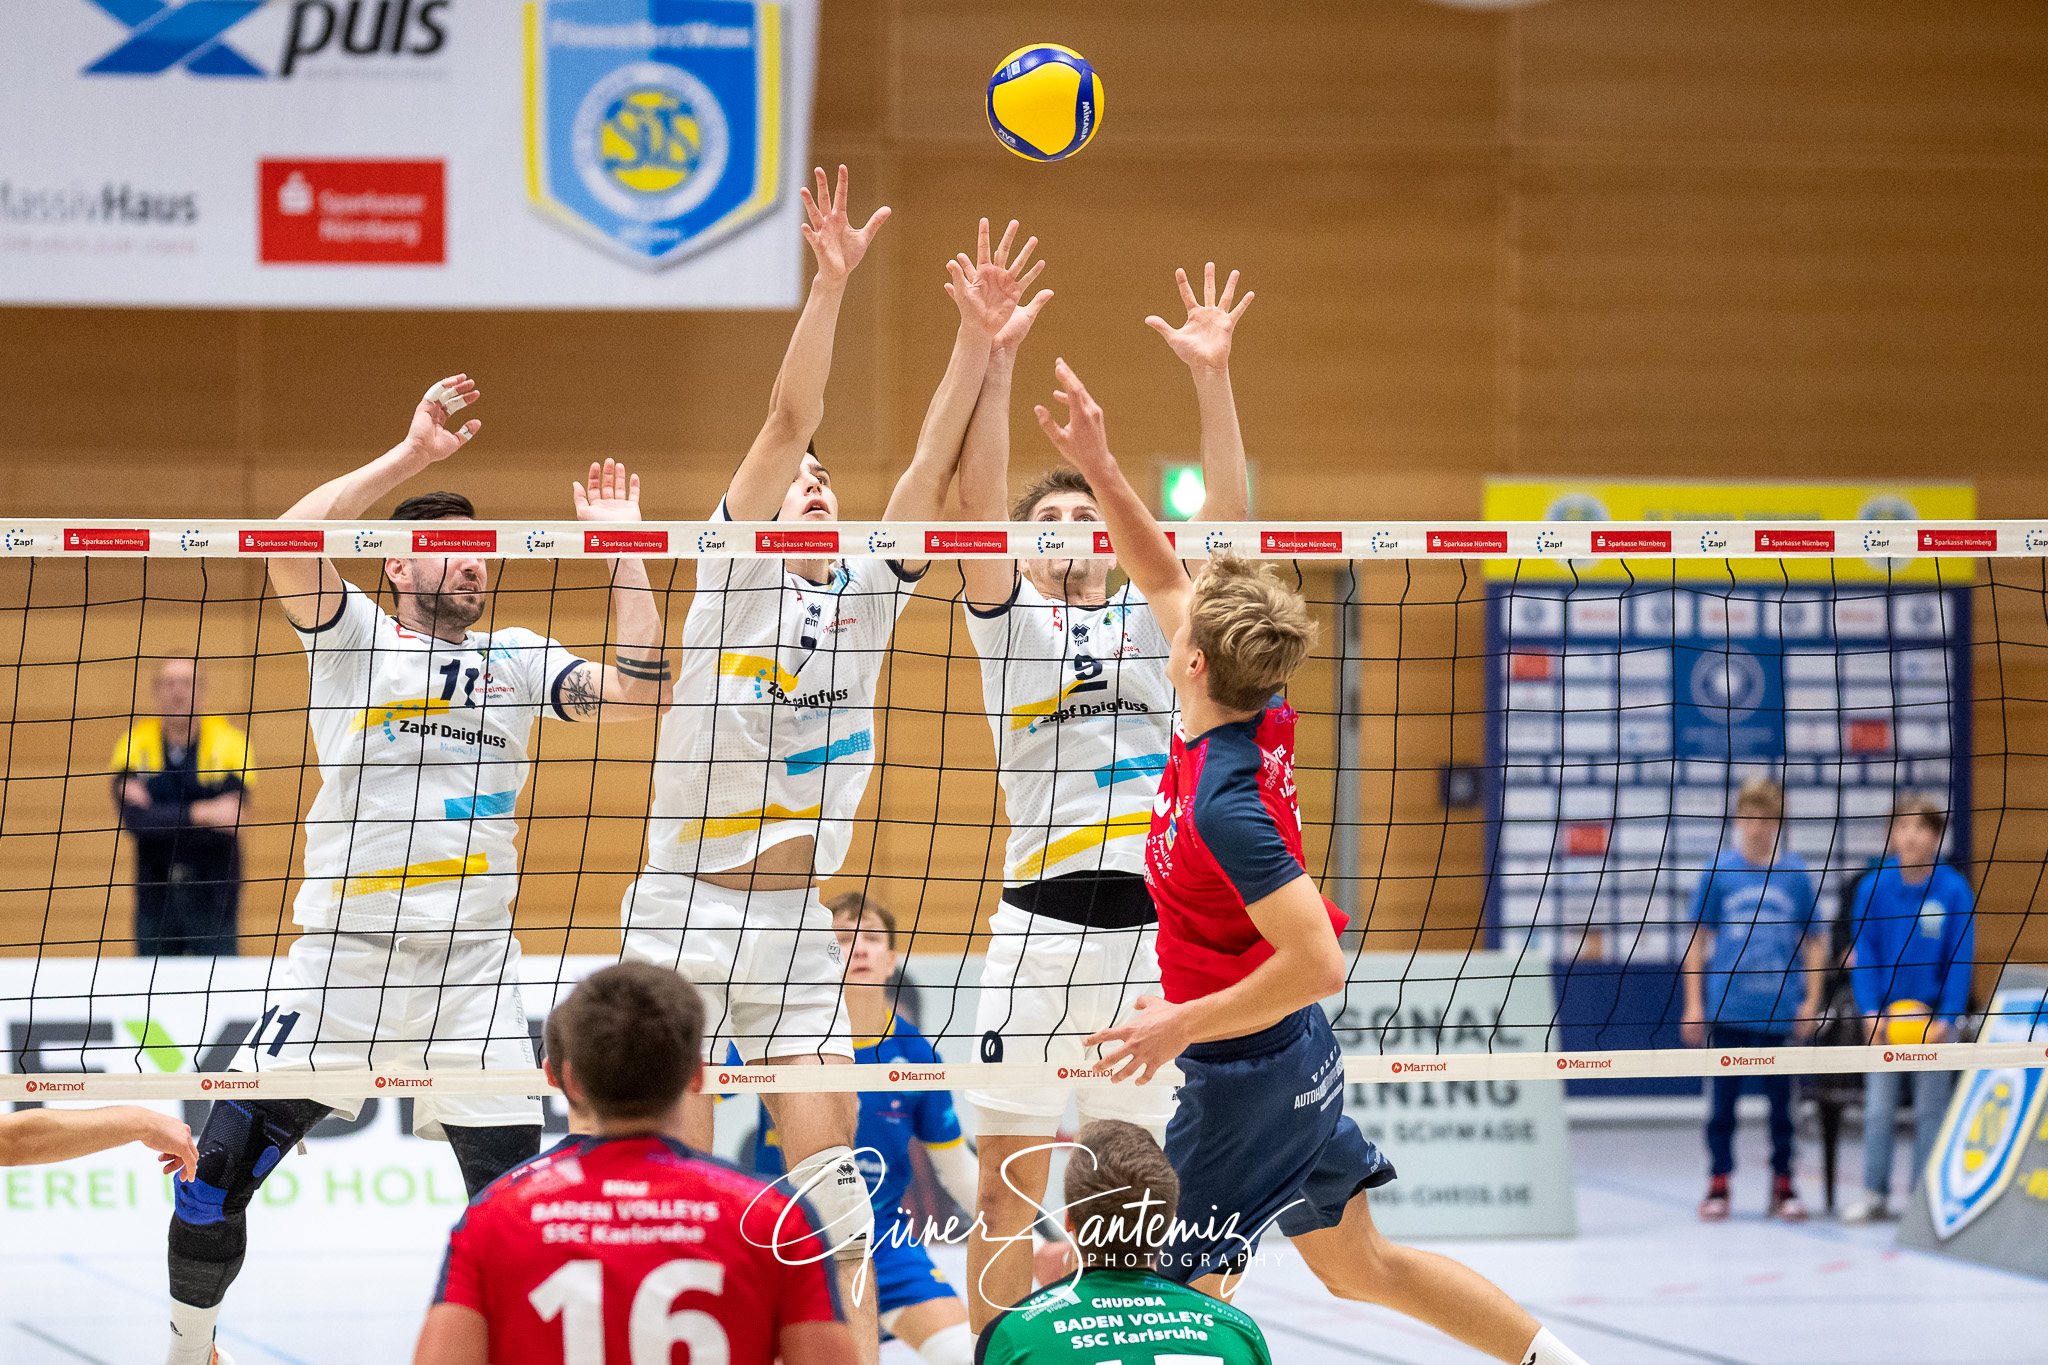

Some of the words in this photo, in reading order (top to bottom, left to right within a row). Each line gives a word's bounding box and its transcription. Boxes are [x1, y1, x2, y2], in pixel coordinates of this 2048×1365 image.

[13, 538, 34, 547] Zapf
[81, 538, 113, 547] Sparkasse
[114, 537, 144, 547] Nürnberg
[189, 539, 209, 548] Zapf
[256, 539, 287, 548] Sparkasse
[288, 538, 318, 548] Nürnberg
[362, 540, 383, 549] Zapf
[429, 539, 460, 548] Sparkasse
[461, 538, 491, 548] Nürnberg
[534, 540, 555, 549] Zapf
[601, 540, 632, 549] Sparkasse
[633, 539, 663, 549] Nürnberg
[705, 541, 725, 550] Zapf
[773, 540, 803, 549] Sparkasse
[804, 539, 834, 549] Nürnberg
[876, 540, 896, 549] Zapf
[941, 540, 972, 549] Sparkasse
[973, 539, 1002, 549] Nürnberg
[1045, 541, 1065, 550] Zapf
[1213, 541, 1232, 549] Zapf
[1277, 540, 1307, 549] Sparkasse
[1308, 539, 1337, 549] Nürnberg
[1379, 541, 1398, 549] Zapf
[1443, 540, 1473, 549] Sparkasse
[1474, 539, 1502, 549] Nürnberg
[1544, 540, 1563, 549] Zapf
[1607, 540, 1637, 549] Sparkasse
[1638, 539, 1666, 549] Nürnberg
[1708, 540, 1727, 549] Zapf
[1771, 539, 1800, 548] Sparkasse
[1801, 538, 1830, 548] Nürnberg
[1871, 539, 1890, 548] Zapf
[1934, 539, 1963, 548] Sparkasse
[1964, 538, 1992, 548] Nürnberg
[2033, 539, 2048, 547] Zap
[1079, 697, 1149, 717] Daigfuss
[399, 719, 438, 738] Zapf
[440, 724, 507, 749] Daigfuss
[248, 1004, 301, 1057] 11
[1333, 1005, 1523, 1048] SONAL
[1732, 1056, 1775, 1066] Marmot
[1895, 1052, 1938, 1062] Marmot
[1403, 1061, 1447, 1072] Marmot
[1568, 1059, 1612, 1069] Marmot
[731, 1074, 776, 1084] Marmot
[901, 1070, 945, 1081] Marmot
[39, 1081, 85, 1092] Marmot
[214, 1080, 260, 1090] Marmot
[387, 1076, 433, 1088] Marmot
[324, 1165, 469, 1207] HOL
[531, 1202, 614, 1223] BADEN
[615, 1200, 721, 1222] VOLLEYS
[591, 1222, 707, 1245] Karlsruhe
[1091, 1296, 1167, 1309] CHUDOBA
[528, 1258, 731, 1365] 16
[1053, 1315, 1124, 1334] BADEN
[1127, 1311, 1215, 1327] VOLLEYS
[1070, 1332, 1109, 1350] SSC
[1112, 1325, 1209, 1345] Karlsruhe
